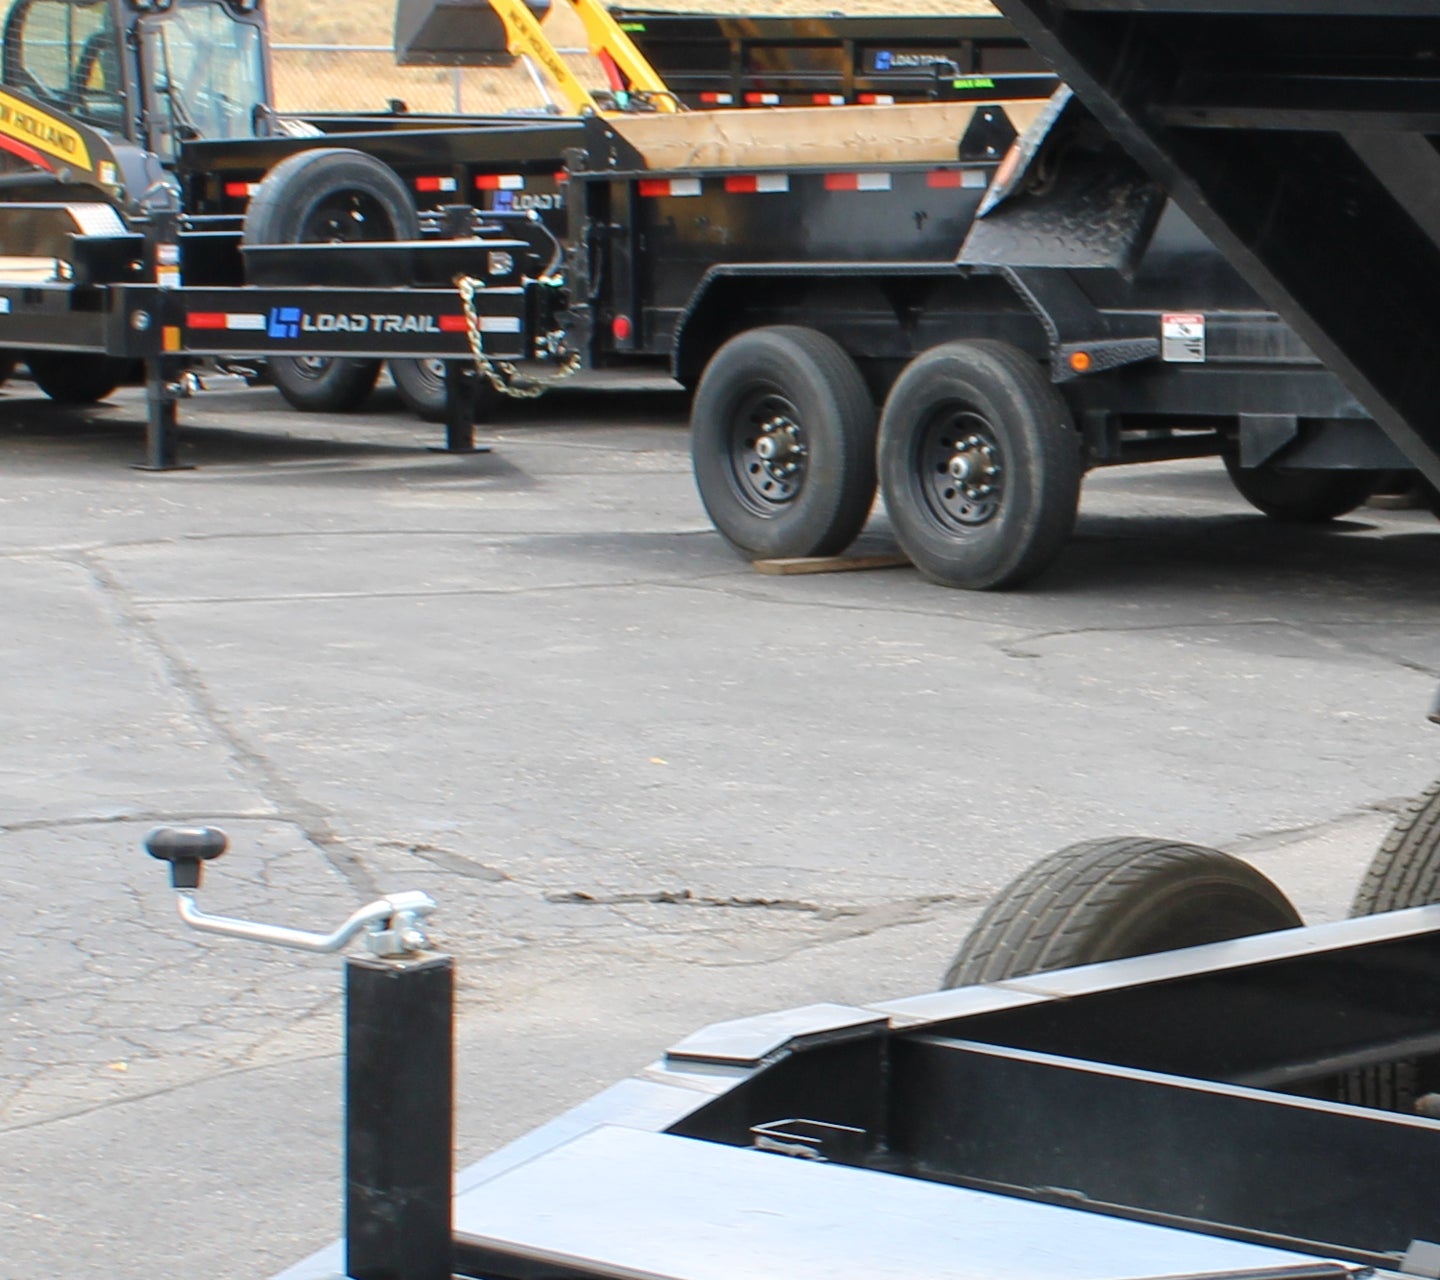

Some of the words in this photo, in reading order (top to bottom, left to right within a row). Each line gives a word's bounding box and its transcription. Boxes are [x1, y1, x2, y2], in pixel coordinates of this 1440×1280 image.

[12, 110, 77, 155] HOLLAND
[512, 193, 553, 210] LOAD
[301, 313, 369, 332] LOAD
[369, 313, 442, 334] TRAIL
